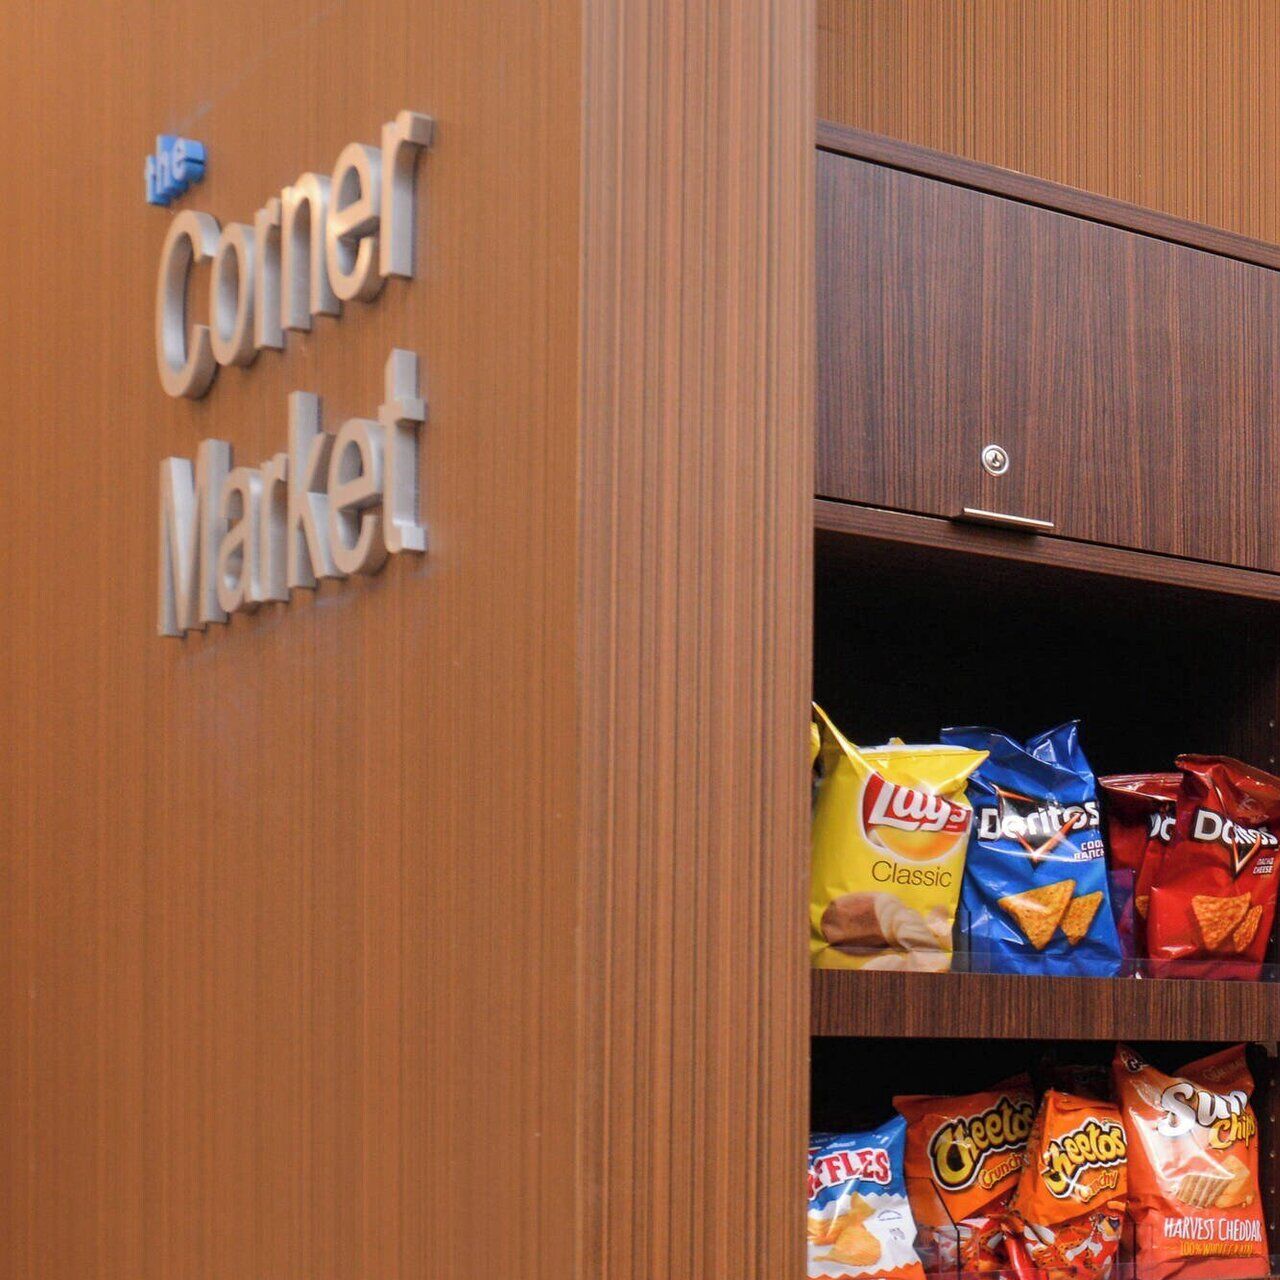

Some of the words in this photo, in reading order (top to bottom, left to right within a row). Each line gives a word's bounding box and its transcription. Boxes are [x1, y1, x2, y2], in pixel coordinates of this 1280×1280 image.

[156, 110, 434, 400] Corner
[157, 348, 426, 637] Market
[978, 800, 1100, 842] Doritos
[871, 860, 952, 888] Classic
[1158, 1083, 1248, 1137] Sun
[1164, 1217, 1215, 1239] HARVEST
[1218, 1217, 1262, 1242] CHEDDAR
